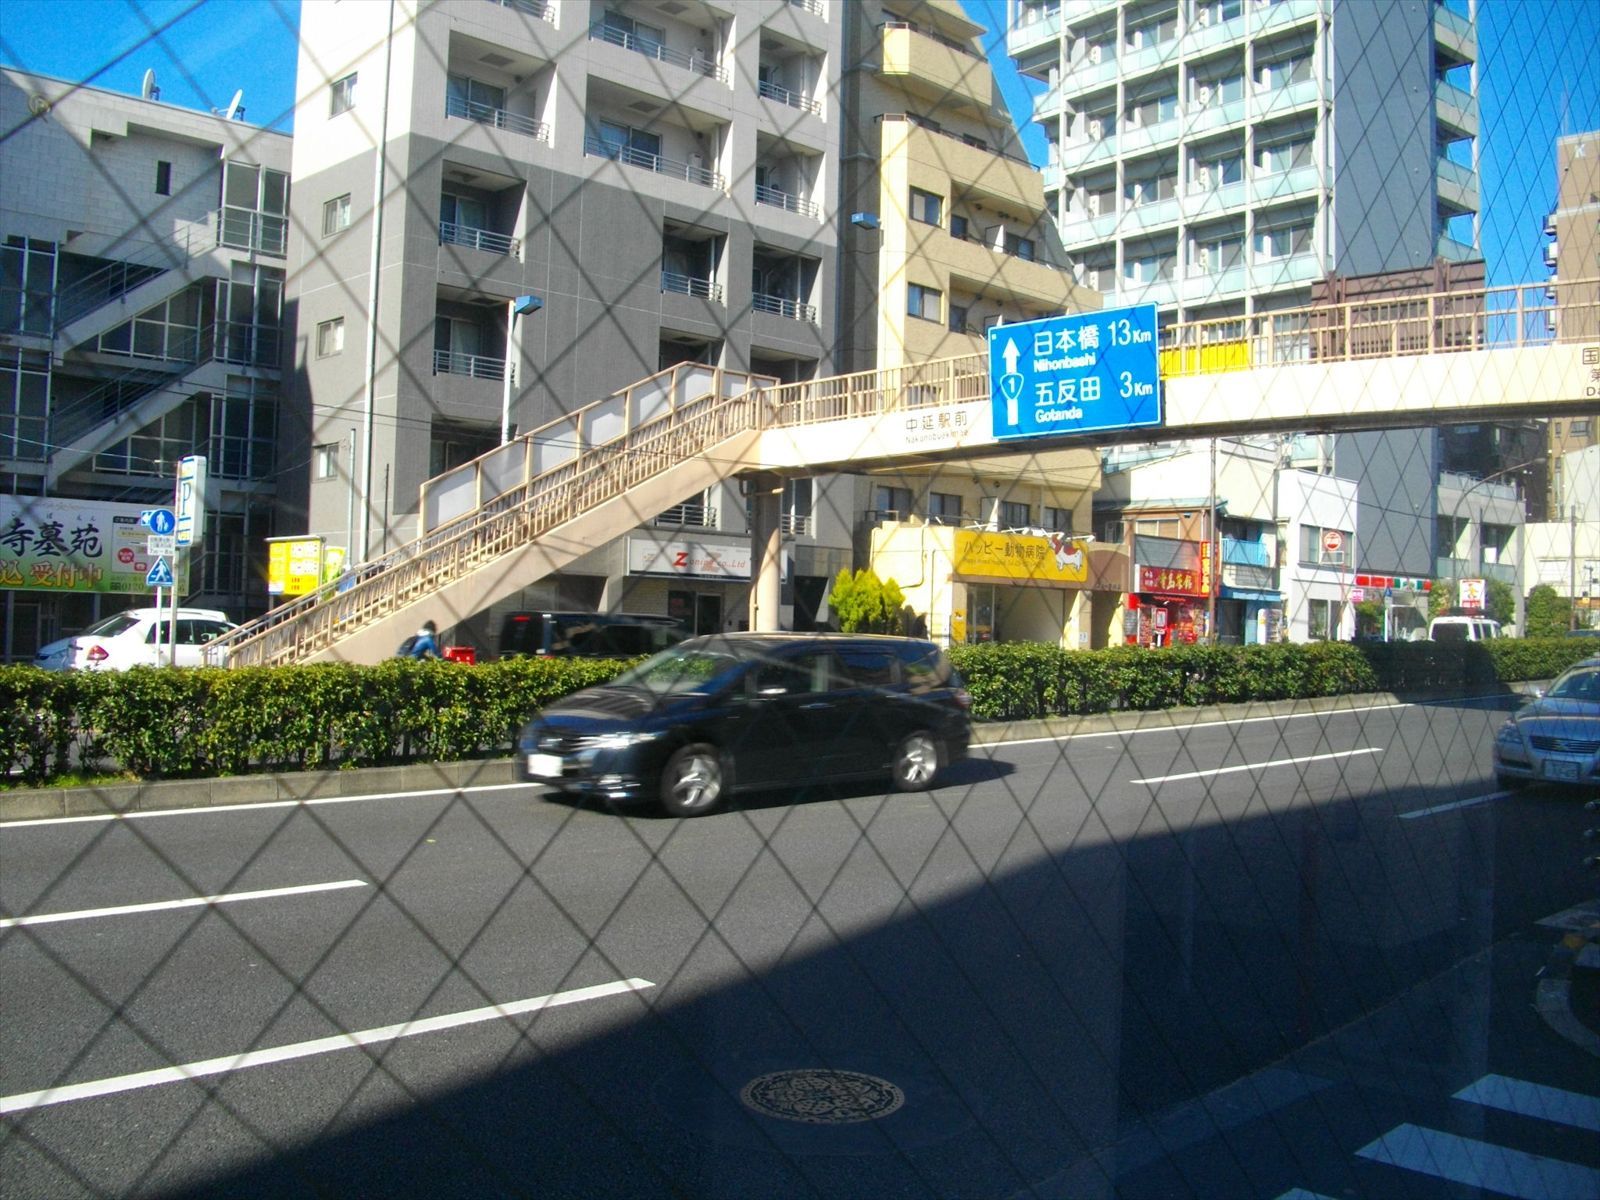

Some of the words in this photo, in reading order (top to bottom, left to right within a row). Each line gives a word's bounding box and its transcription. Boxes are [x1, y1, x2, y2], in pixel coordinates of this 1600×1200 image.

[1034, 324, 1100, 357] 日本橋
[1033, 352, 1096, 373] Nihonbashi
[1007, 377, 1015, 393] 1
[1034, 376, 1101, 407] 五反田
[905, 410, 968, 432] 中延駅前
[1034, 406, 1083, 424] Gotanda
[181, 482, 192, 516] P
[0, 517, 103, 557] 寺墓苑
[963, 540, 1046, 561] ハッピー動物病院
